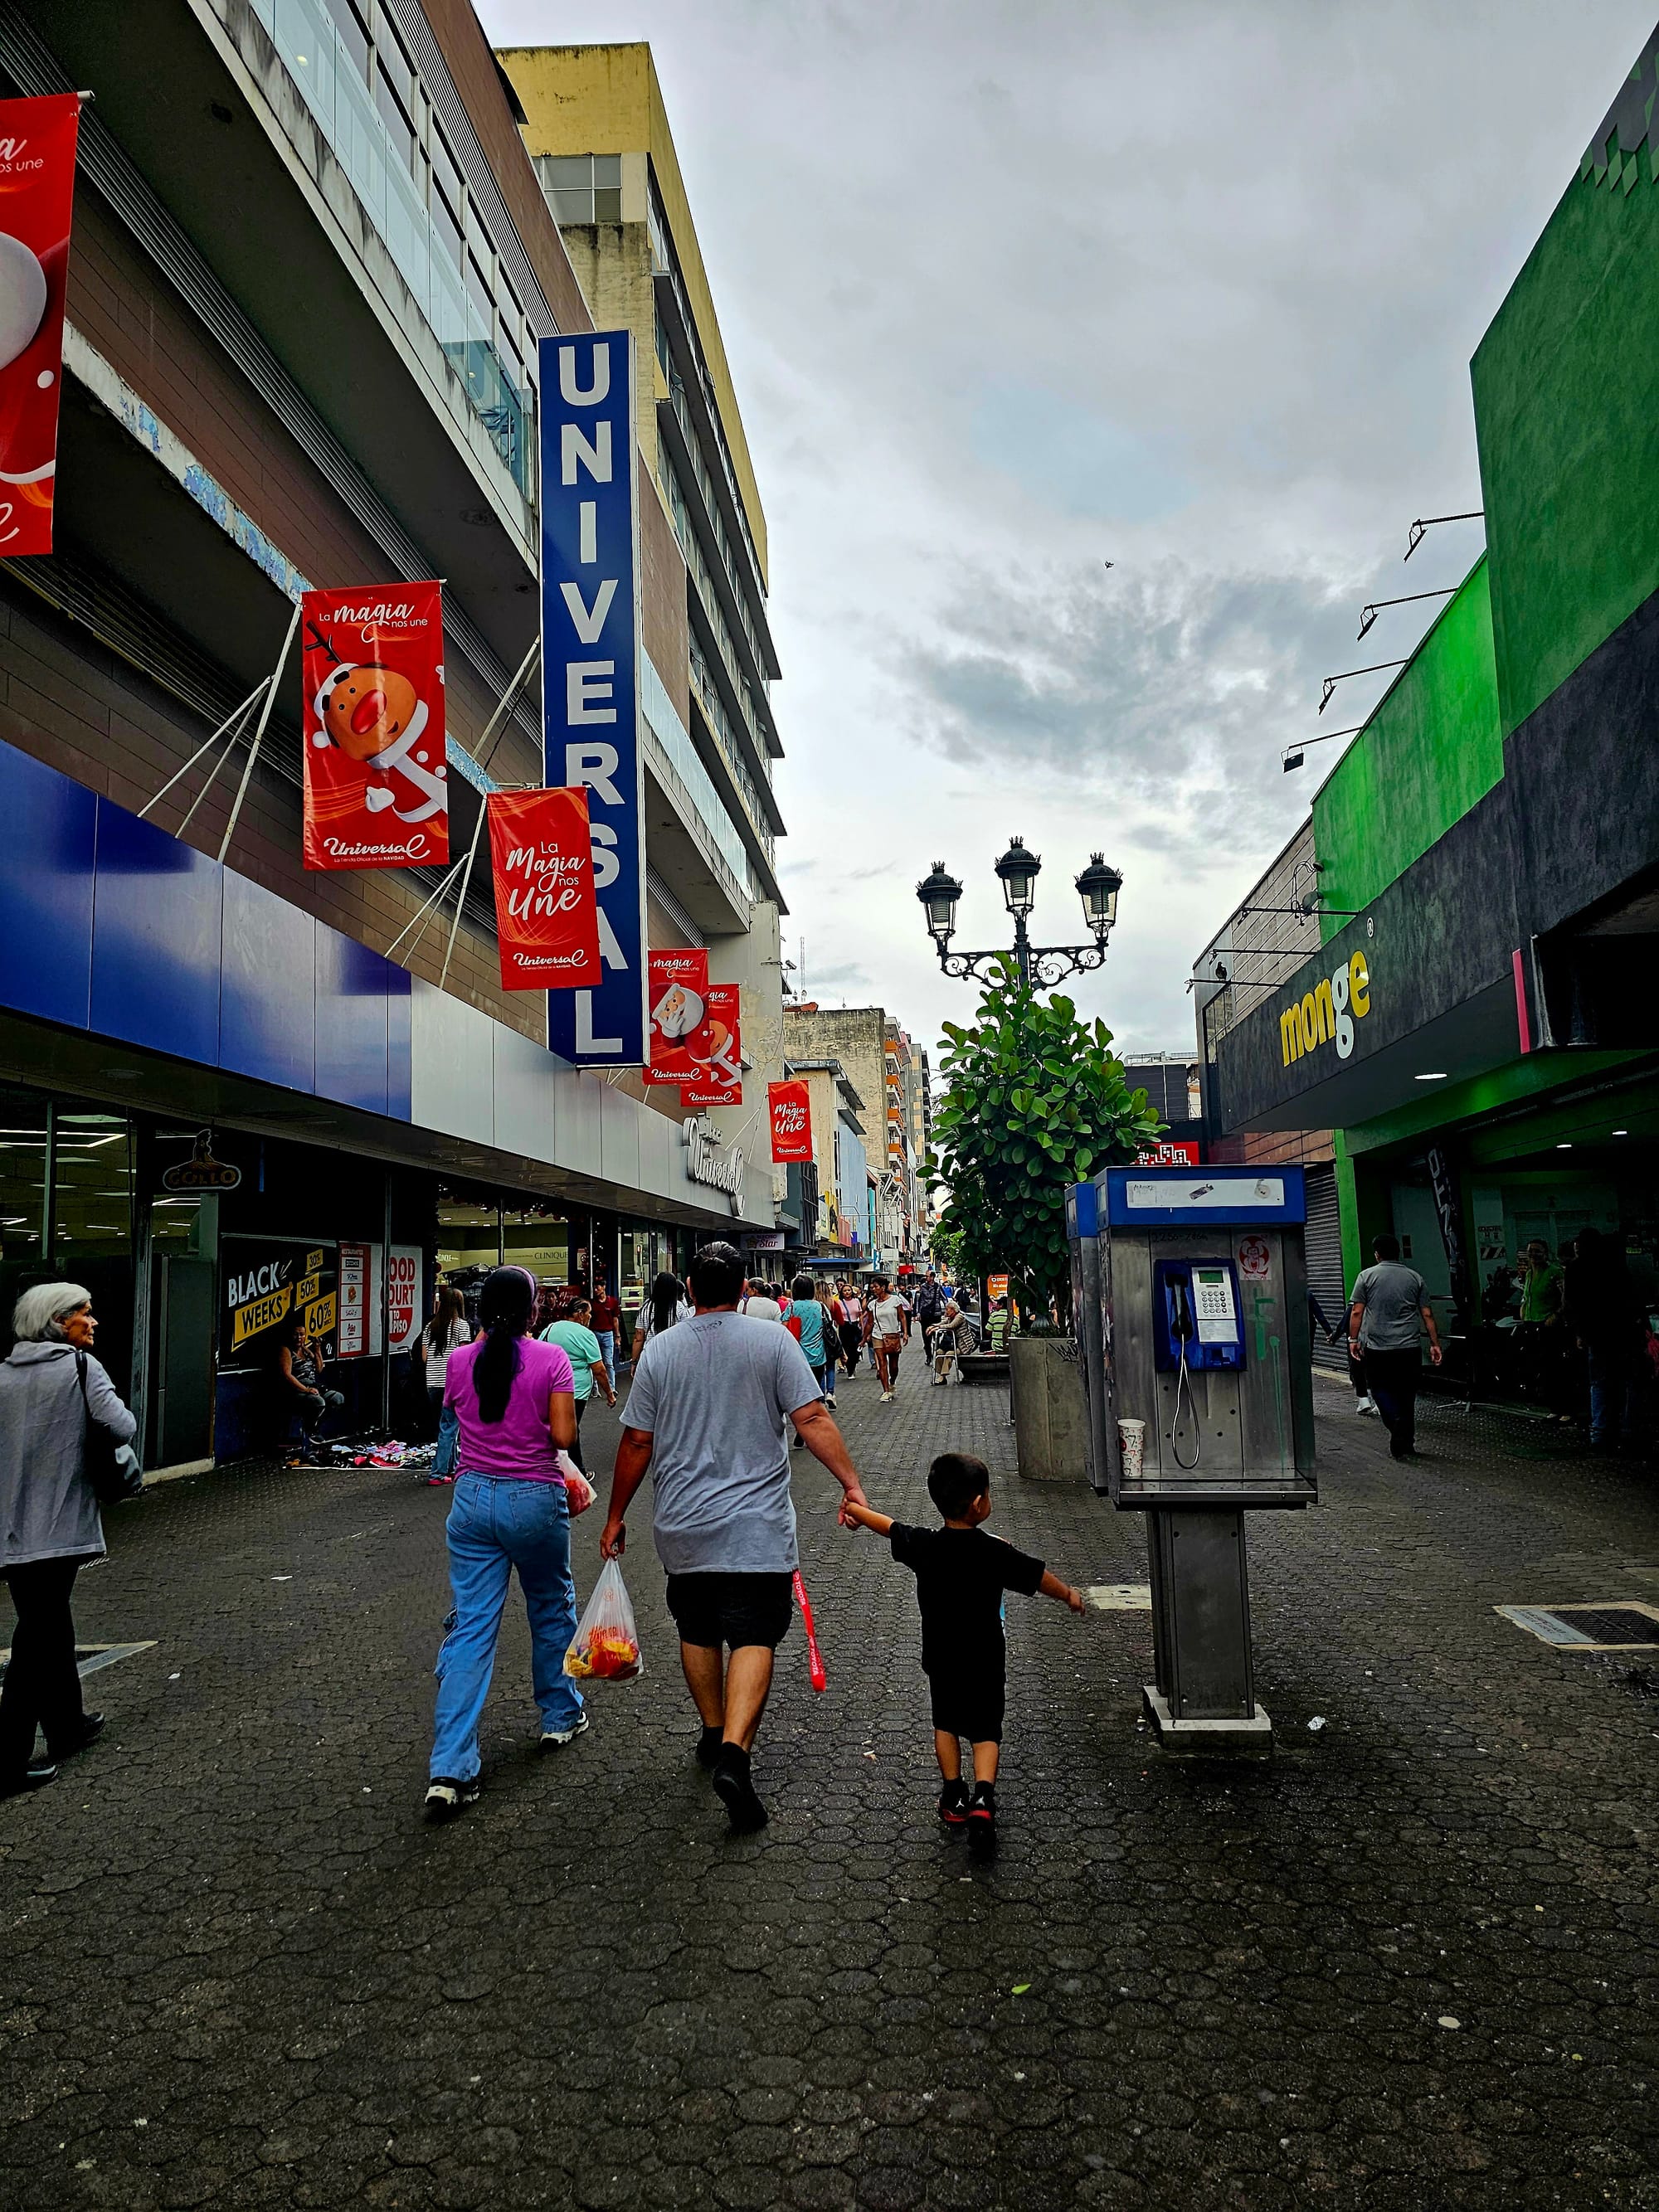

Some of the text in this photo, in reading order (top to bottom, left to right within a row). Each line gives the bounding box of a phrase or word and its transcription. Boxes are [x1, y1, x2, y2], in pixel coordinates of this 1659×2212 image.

[0, 158, 45, 173] os une
[319, 603, 415, 644] La magia
[392, 618, 428, 628] nos une
[324, 834, 431, 859] Universal
[541, 841, 558, 853] La
[505, 847, 586, 892] Magia
[558, 877, 579, 887] nos
[508, 887, 581, 921] Une
[513, 949, 588, 967] Universal
[654, 958, 693, 978] magia
[1280, 950, 1370, 1067] monge
[651, 1067, 703, 1081] Universal
[688, 1091, 734, 1103] Universal
[775, 1103, 807, 1123] Magia
[775, 1120, 805, 1135] Une
[758, 1238, 778, 1247] Star
[389, 1257, 416, 1282] OOD
[228, 1262, 280, 1307] BLACK
[299, 1278, 315, 1299] 50%
[389, 1284, 415, 1305] OURT
[241, 1295, 283, 1334] WEEKS
[309, 1300, 332, 1334] 60%
[392, 1320, 407, 1334] PISO
[795, 1581, 806, 1606] TOYOTA
[810, 1648, 820, 1676] TOYOTA
